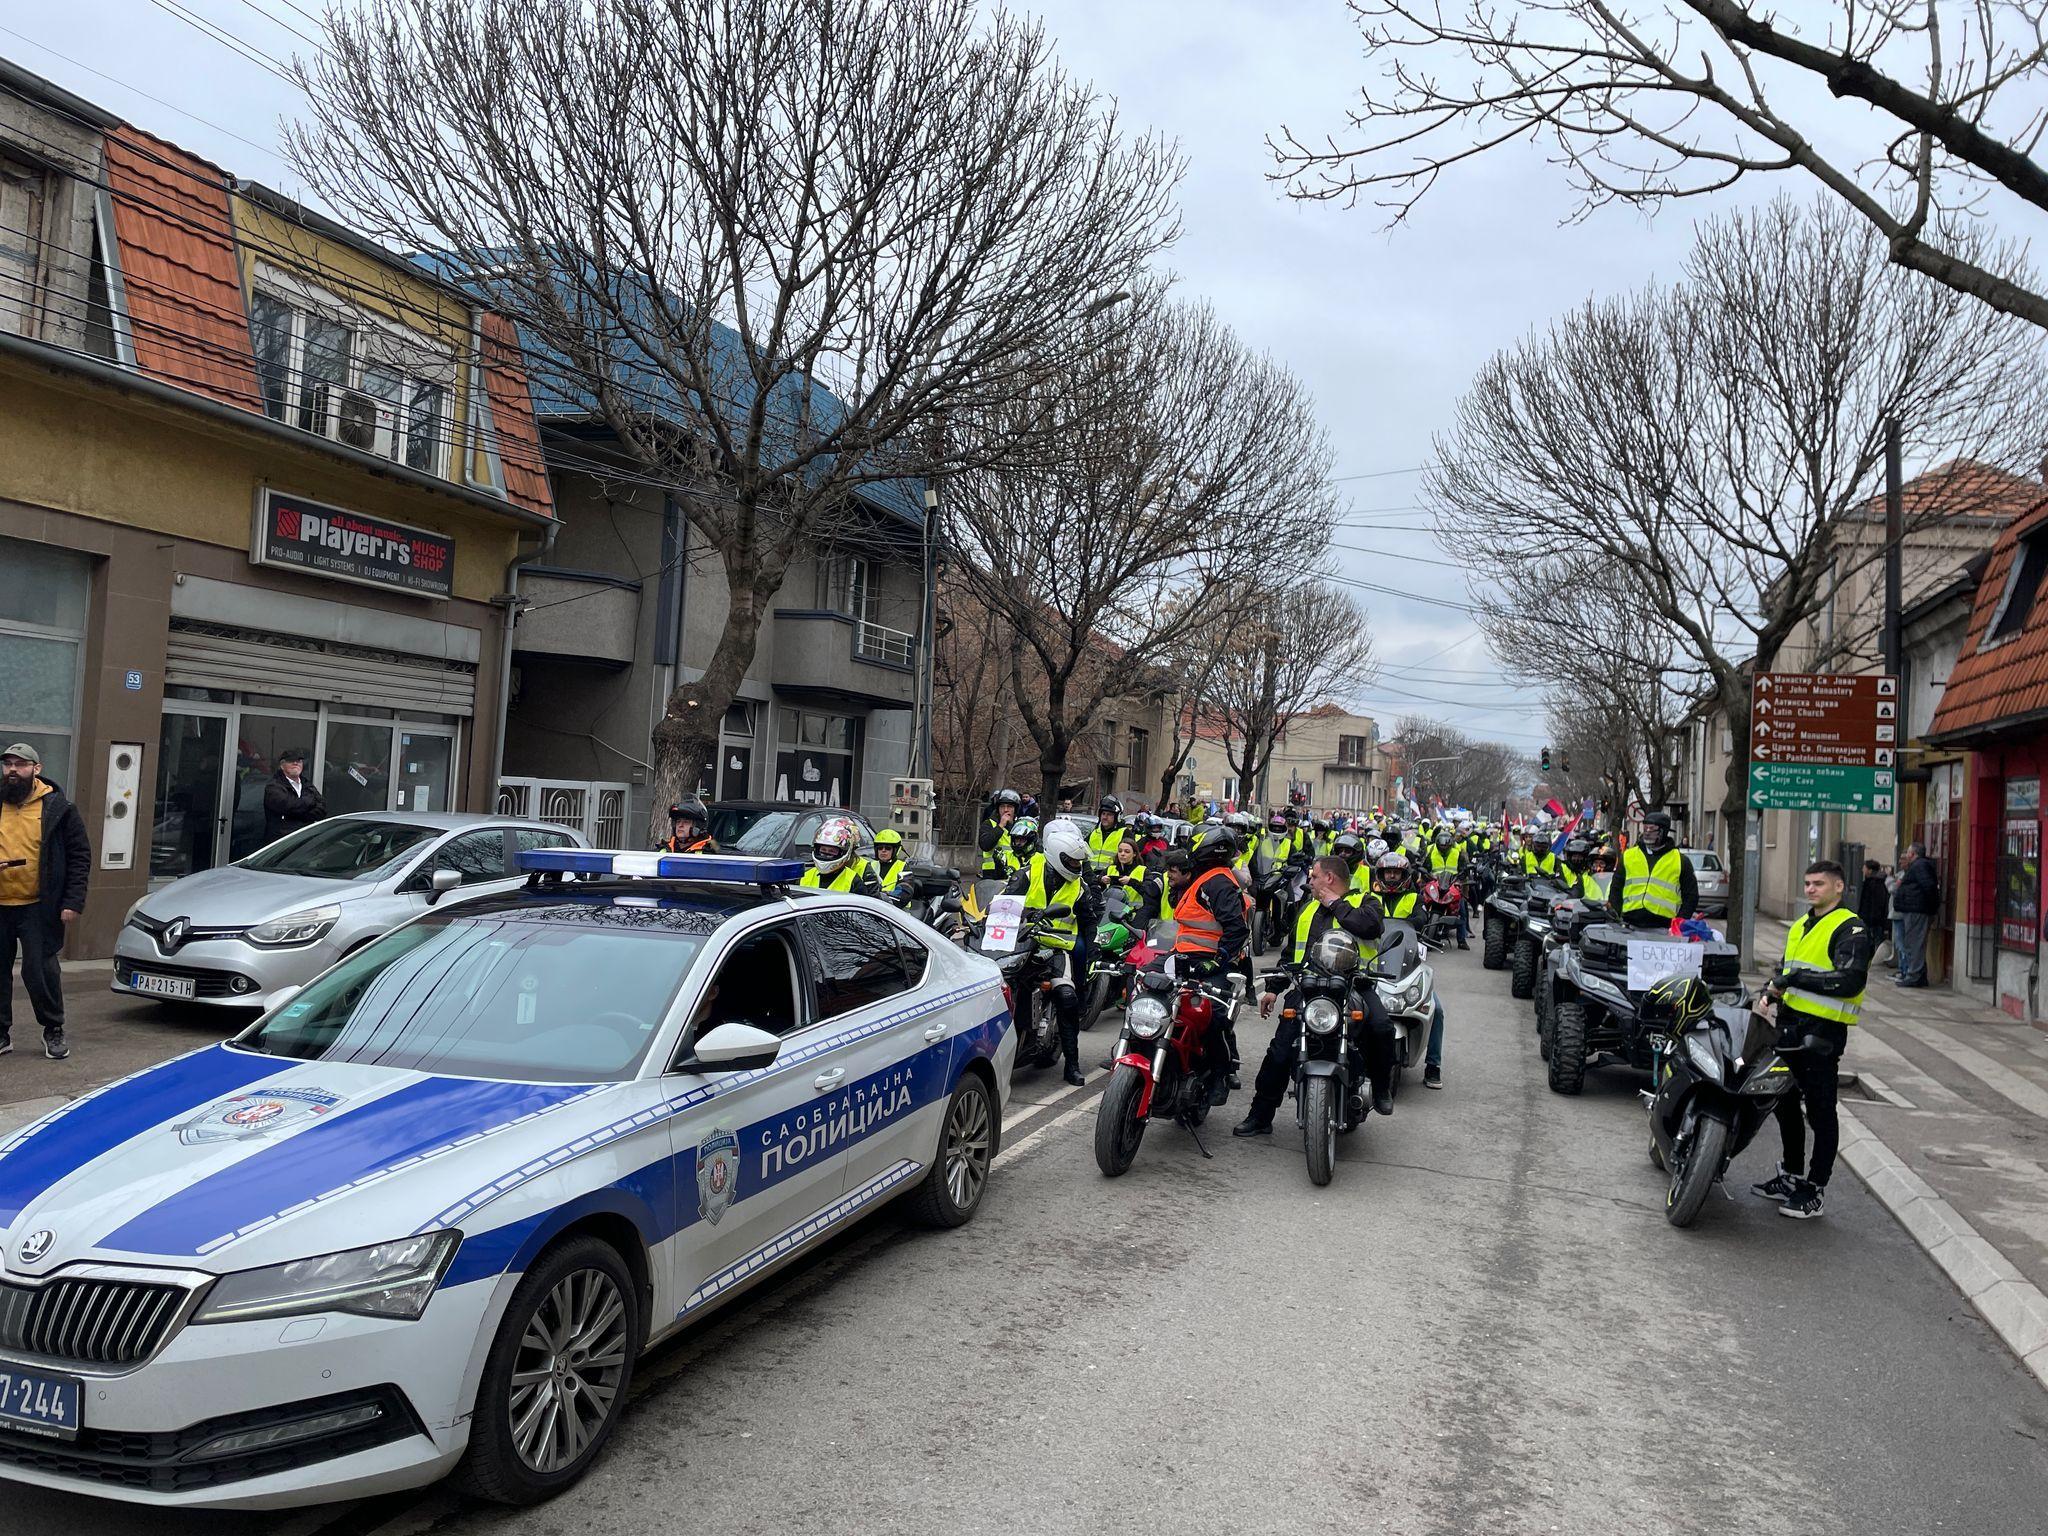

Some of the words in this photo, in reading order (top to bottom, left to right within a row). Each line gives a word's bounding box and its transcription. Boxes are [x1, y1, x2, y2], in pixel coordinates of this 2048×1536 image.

[300, 514, 410, 565] Player.rs
[412, 540, 446, 560] MUSIC
[270, 546, 304, 562] PRO-AUDIO
[314, 556, 330, 567] LIGHT
[330, 559, 355, 572] SYSTEMS
[372, 567, 400, 582] EQUIPMENT
[413, 554, 444, 572] SHOP
[128, 674, 140, 684] 53
[1788, 686, 1808, 694] John
[1812, 686, 1853, 697] Monastery
[1773, 708, 1792, 716] Latin
[1798, 708, 1825, 718] Church
[1800, 730, 1840, 741] Monument
[1838, 755, 1866, 764] Church
[1796, 776, 1814, 785] Cave
[1770, 798, 1784, 808] The
[138, 974, 150, 990] PA
[761, 1067, 913, 1146] САОБРАЋАЈНА
[761, 1086, 912, 1180] ПОЛИЦИЈА
